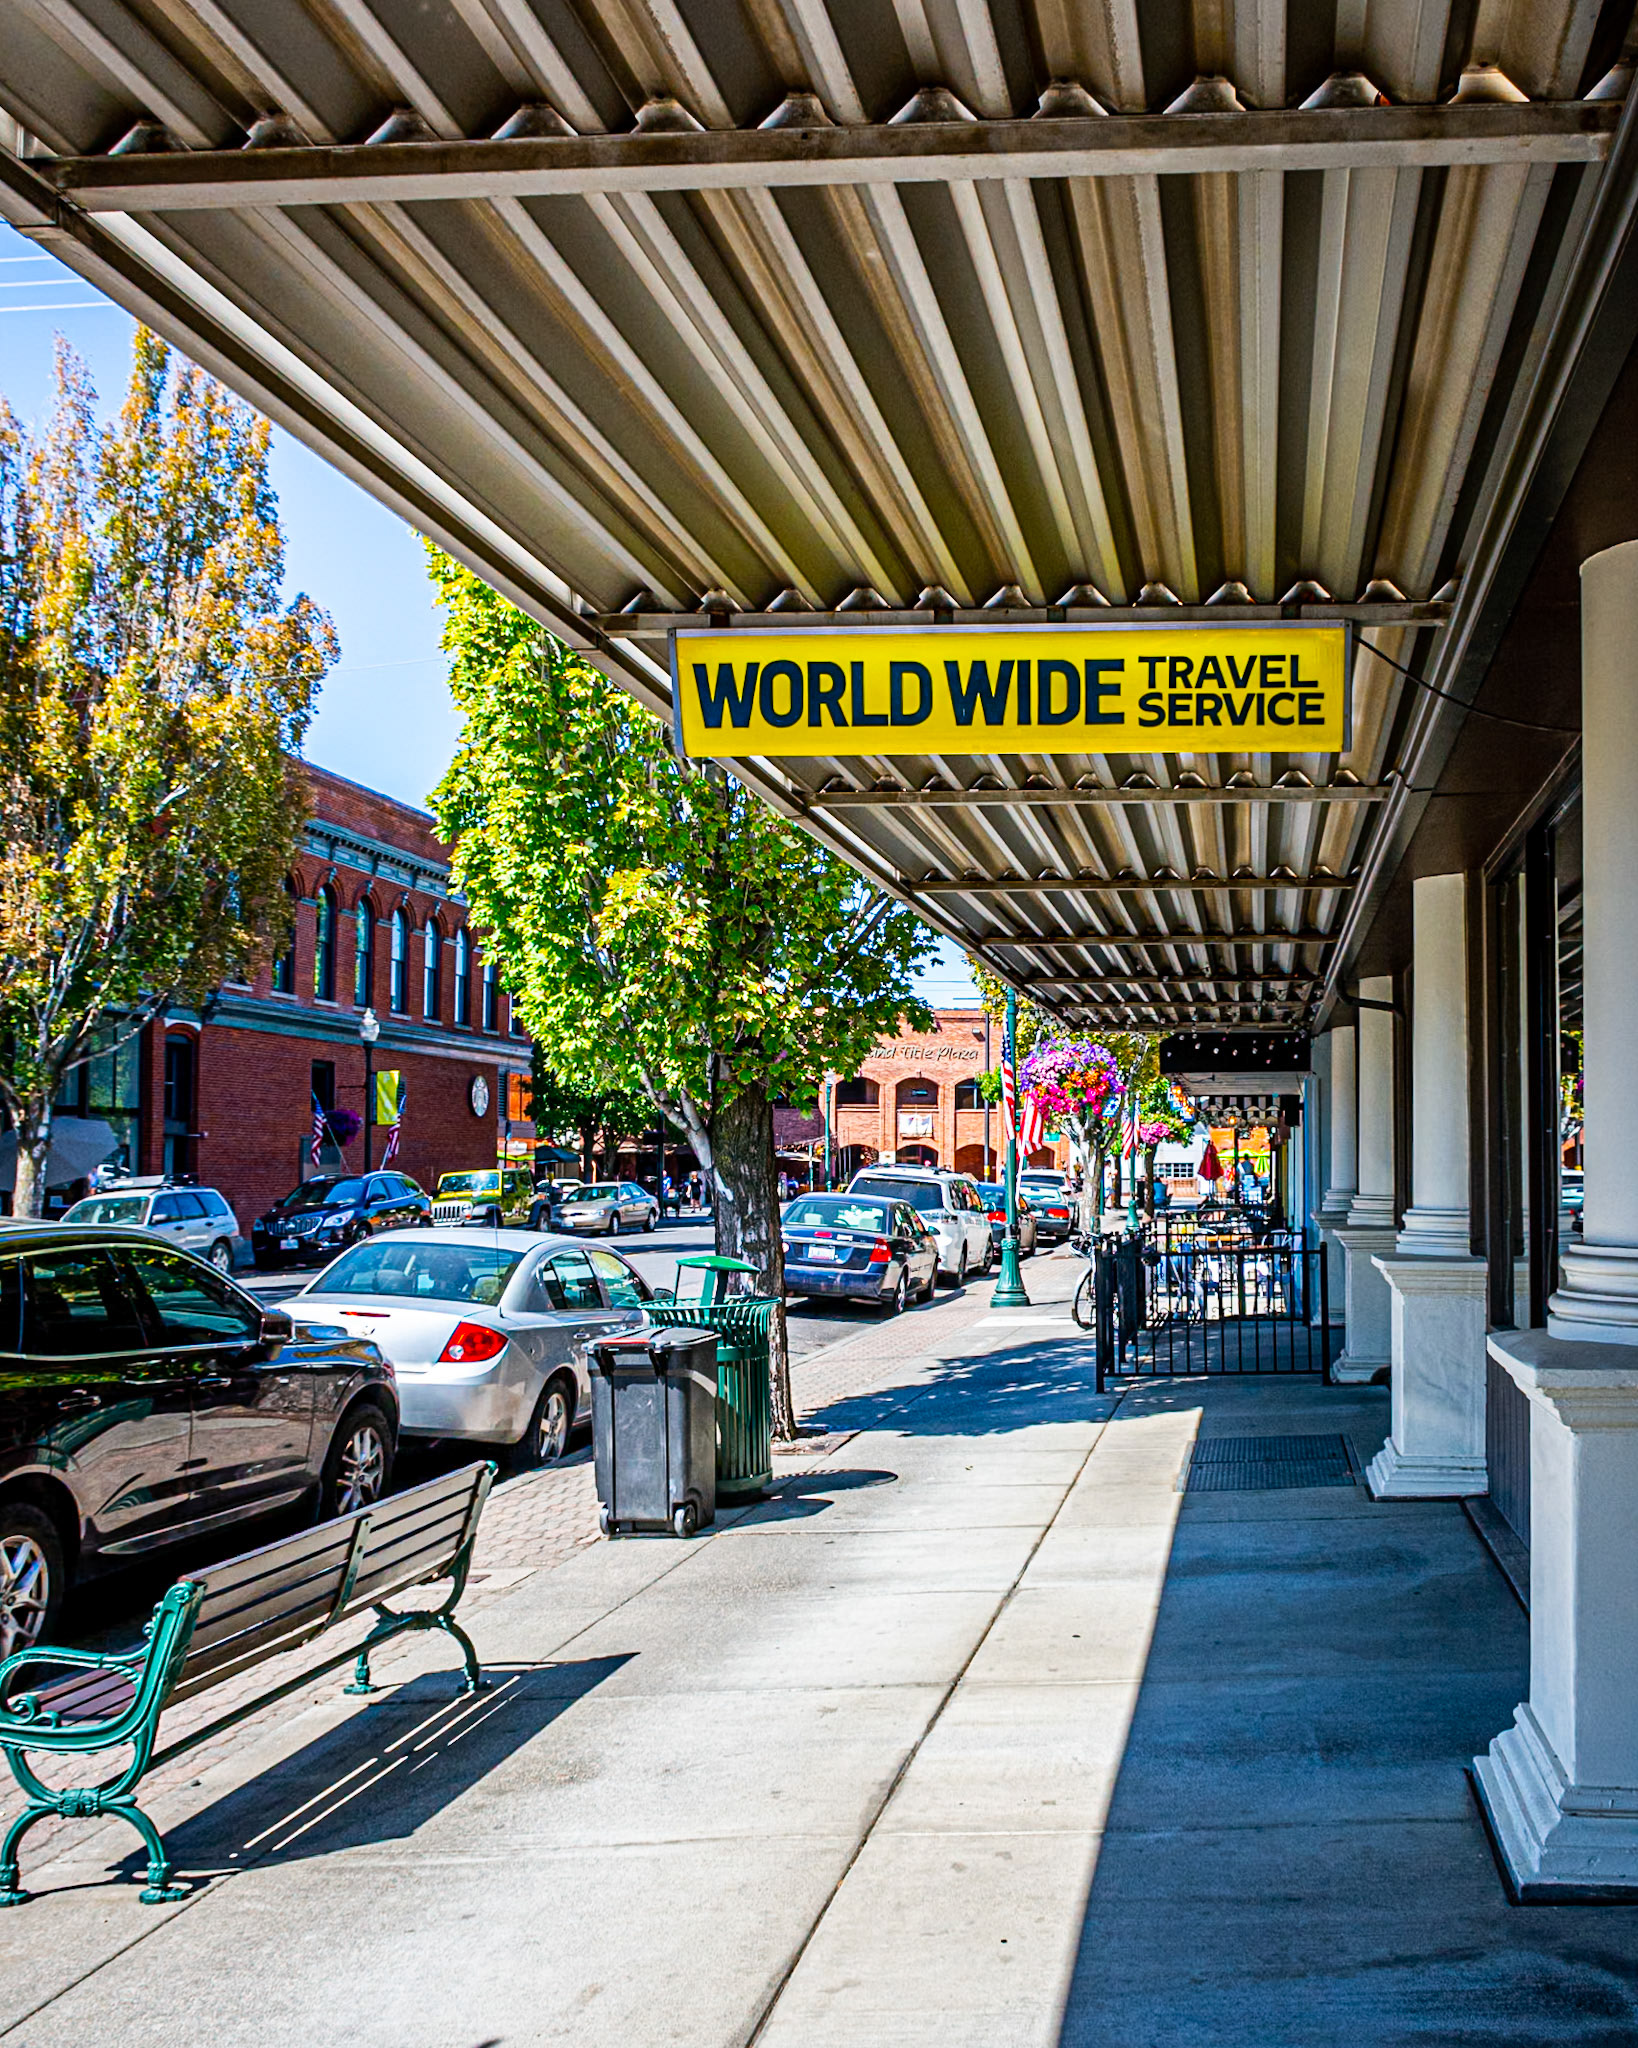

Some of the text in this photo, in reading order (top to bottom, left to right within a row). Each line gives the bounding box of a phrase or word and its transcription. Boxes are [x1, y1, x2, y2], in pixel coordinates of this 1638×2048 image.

[1138, 654, 1319, 689] TRAVEL
[692, 658, 1125, 728] WORLD WIDE
[1138, 691, 1325, 727] SERVICE
[901, 1044, 935, 1060] Title
[936, 1044, 979, 1061] Plaza
